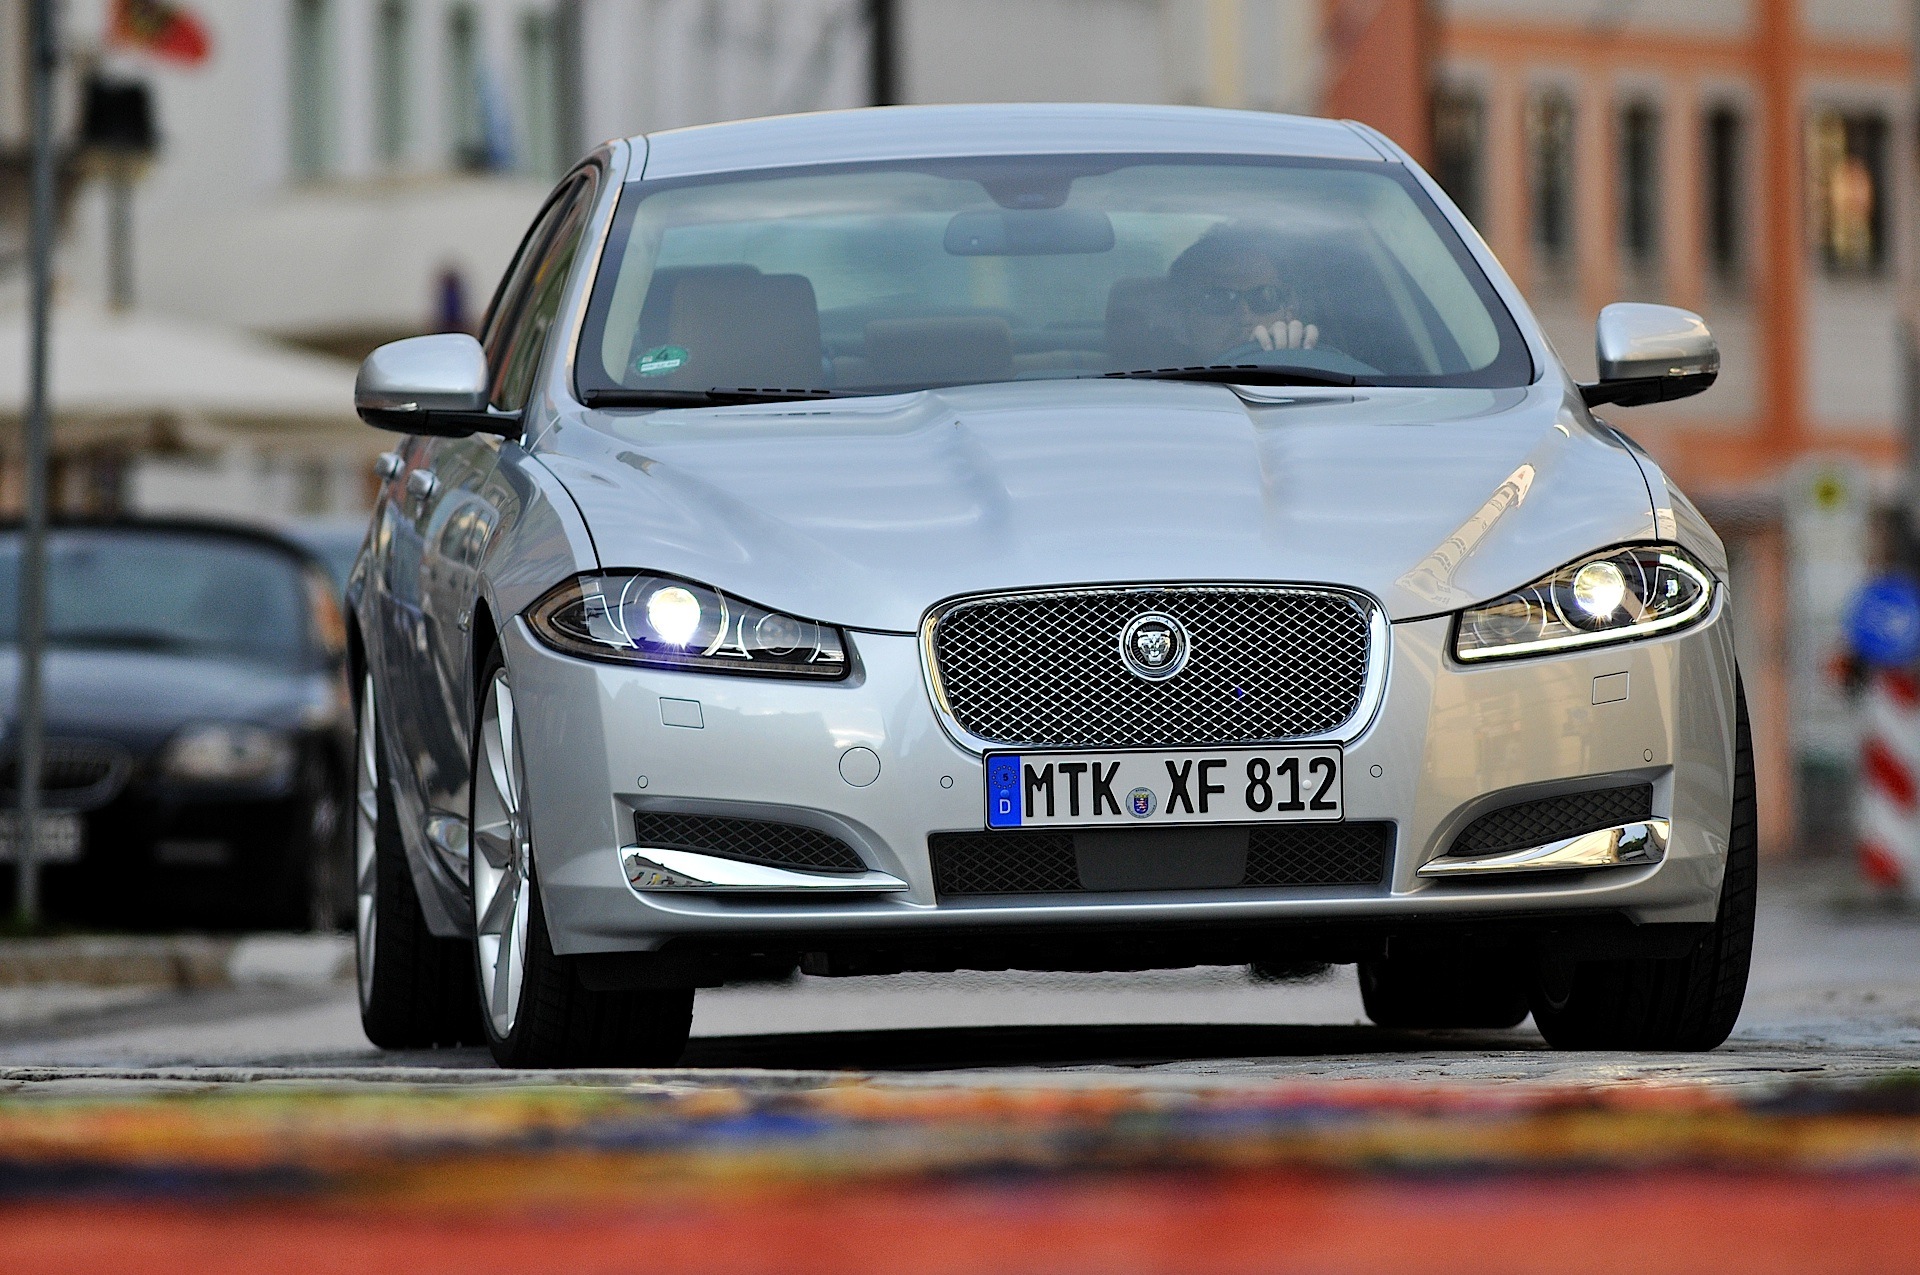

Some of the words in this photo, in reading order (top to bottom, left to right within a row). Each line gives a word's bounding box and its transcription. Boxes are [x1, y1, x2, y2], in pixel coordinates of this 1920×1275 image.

[1131, 616, 1178, 633] JAGUAR
[1024, 761, 1122, 818] MTK
[1164, 758, 1228, 815] XF
[1245, 756, 1338, 813] 812
[999, 798, 1011, 814] D
